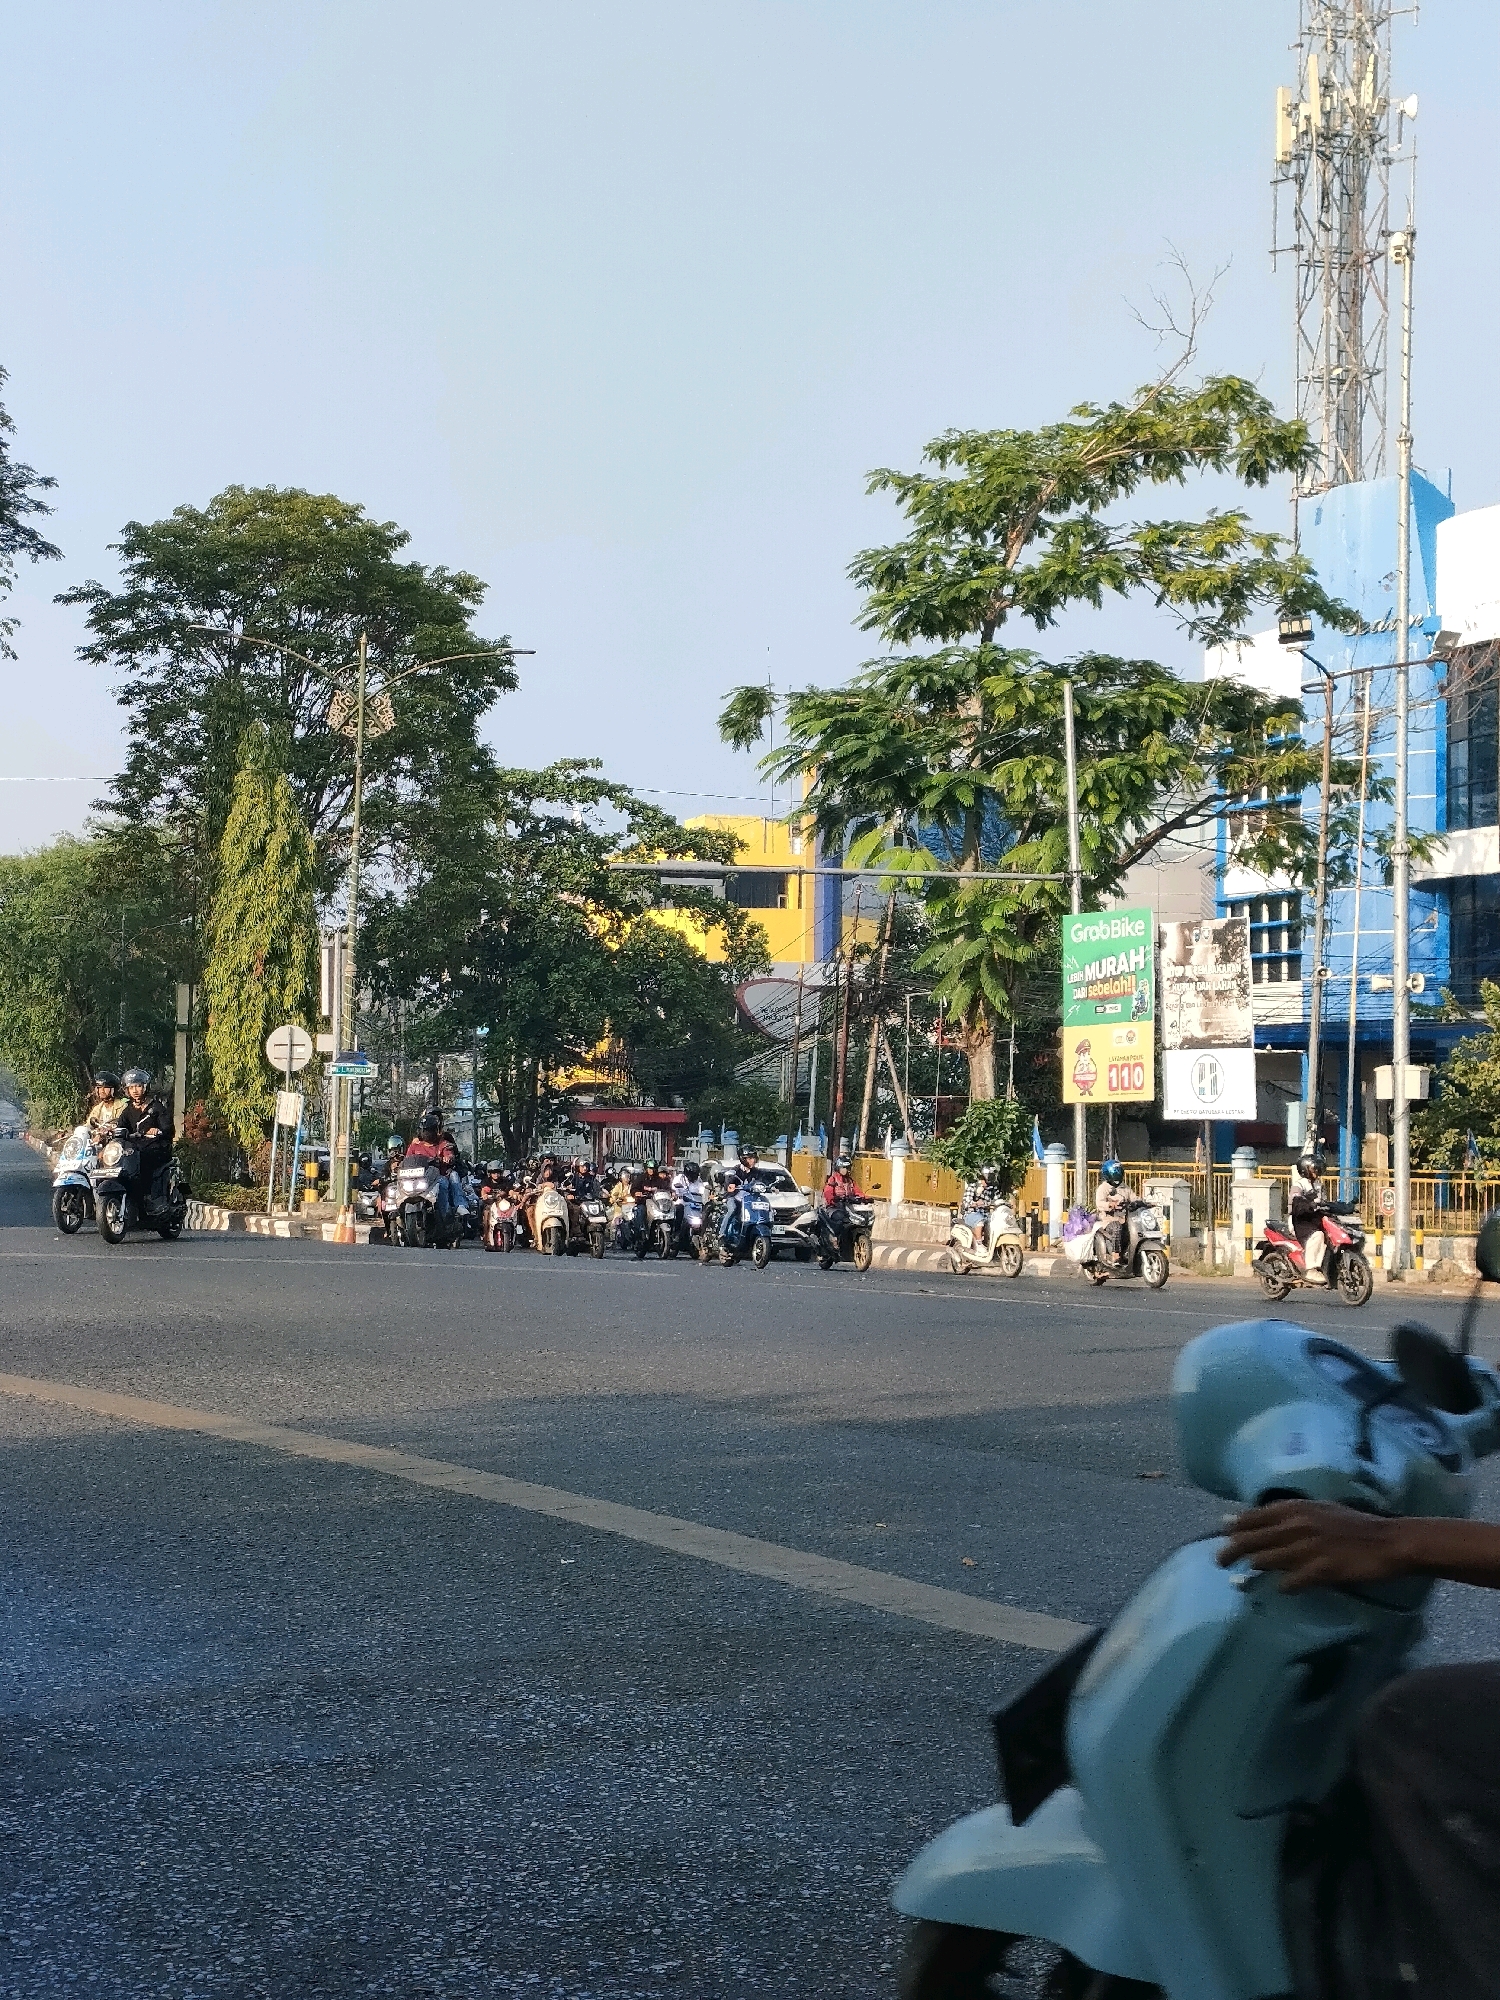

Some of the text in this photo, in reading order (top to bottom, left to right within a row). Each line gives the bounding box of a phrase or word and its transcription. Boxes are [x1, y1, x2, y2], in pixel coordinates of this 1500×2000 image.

[1070, 916, 1145, 943] GrabBike
[1067, 945, 1145, 984] LEBIH MURAH
[1073, 974, 1136, 1000] DARI sebelah!!
[1110, 1065, 1143, 1088] 110
